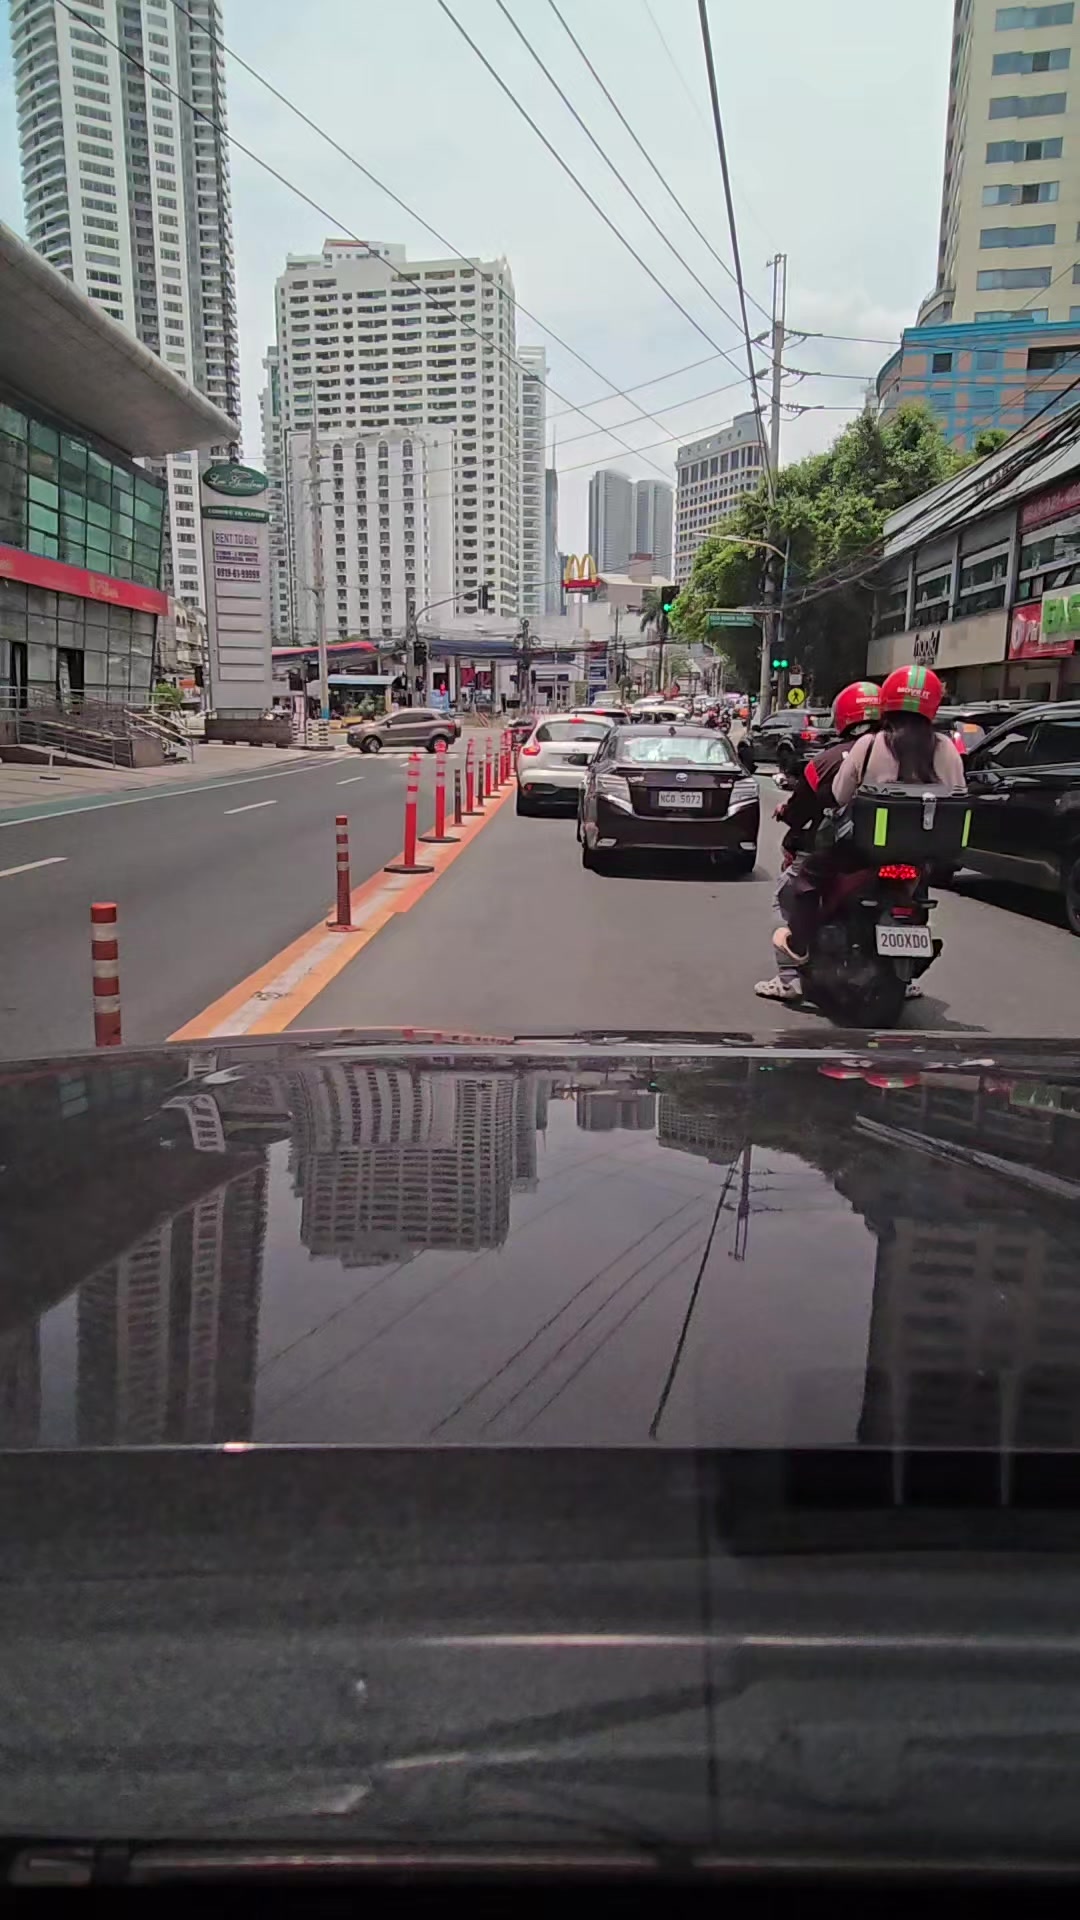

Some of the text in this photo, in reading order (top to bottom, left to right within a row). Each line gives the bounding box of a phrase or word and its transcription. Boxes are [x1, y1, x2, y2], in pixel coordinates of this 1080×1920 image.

[215, 532, 257, 544] RENT TO BUY
